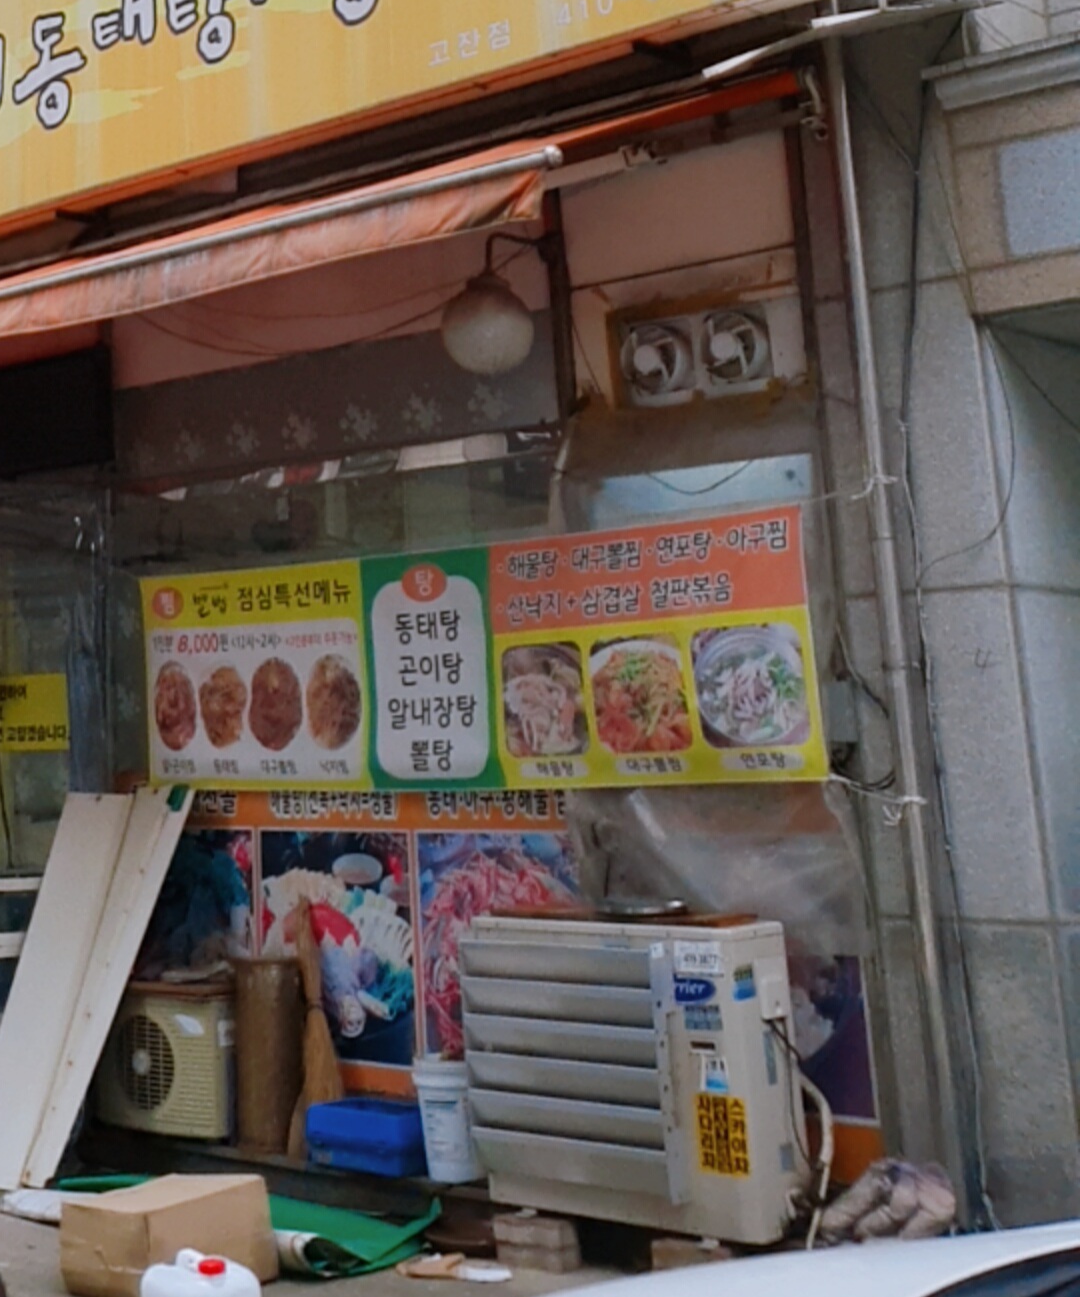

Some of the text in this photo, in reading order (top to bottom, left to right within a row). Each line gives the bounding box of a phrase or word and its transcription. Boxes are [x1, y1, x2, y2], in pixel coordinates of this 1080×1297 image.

[506, 551, 559, 578] 해물탕
[655, 533, 713, 565] 연포탕
[726, 519, 789, 552] 아구찜
[237, 580, 351, 613] 점심특선메뉴
[581, 584, 641, 616] 삼겹살
[650, 572, 733, 608] 철판볶음
[394, 609, 461, 646] 동태탕
[397, 652, 465, 686] 곤이탕
[386, 695, 478, 731] 알내장탕
